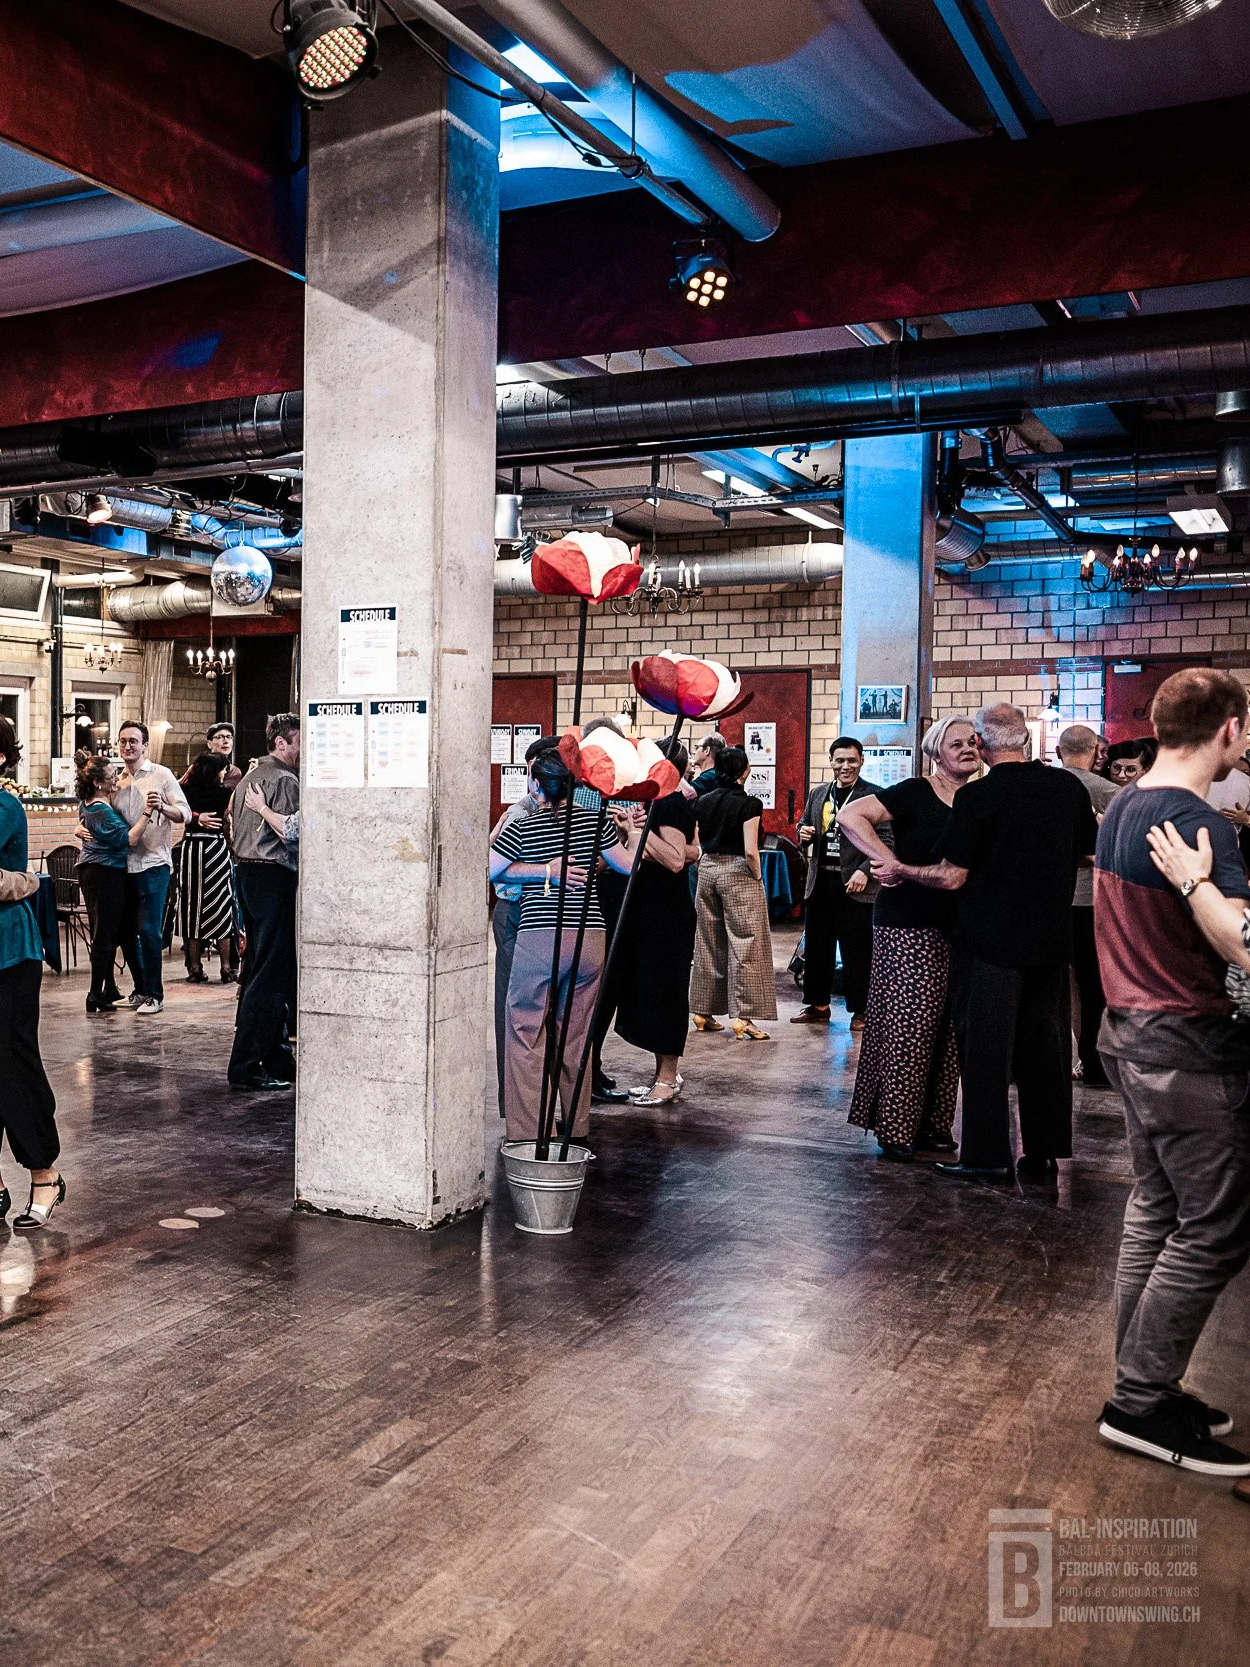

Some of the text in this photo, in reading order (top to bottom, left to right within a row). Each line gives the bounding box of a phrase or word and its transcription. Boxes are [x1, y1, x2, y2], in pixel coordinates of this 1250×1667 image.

[349, 609, 391, 622] SCHEDULE
[317, 704, 357, 716] SCHEDULE
[377, 702, 420, 715] SCHEDULE
[505, 768, 524, 776] FRIDAY
